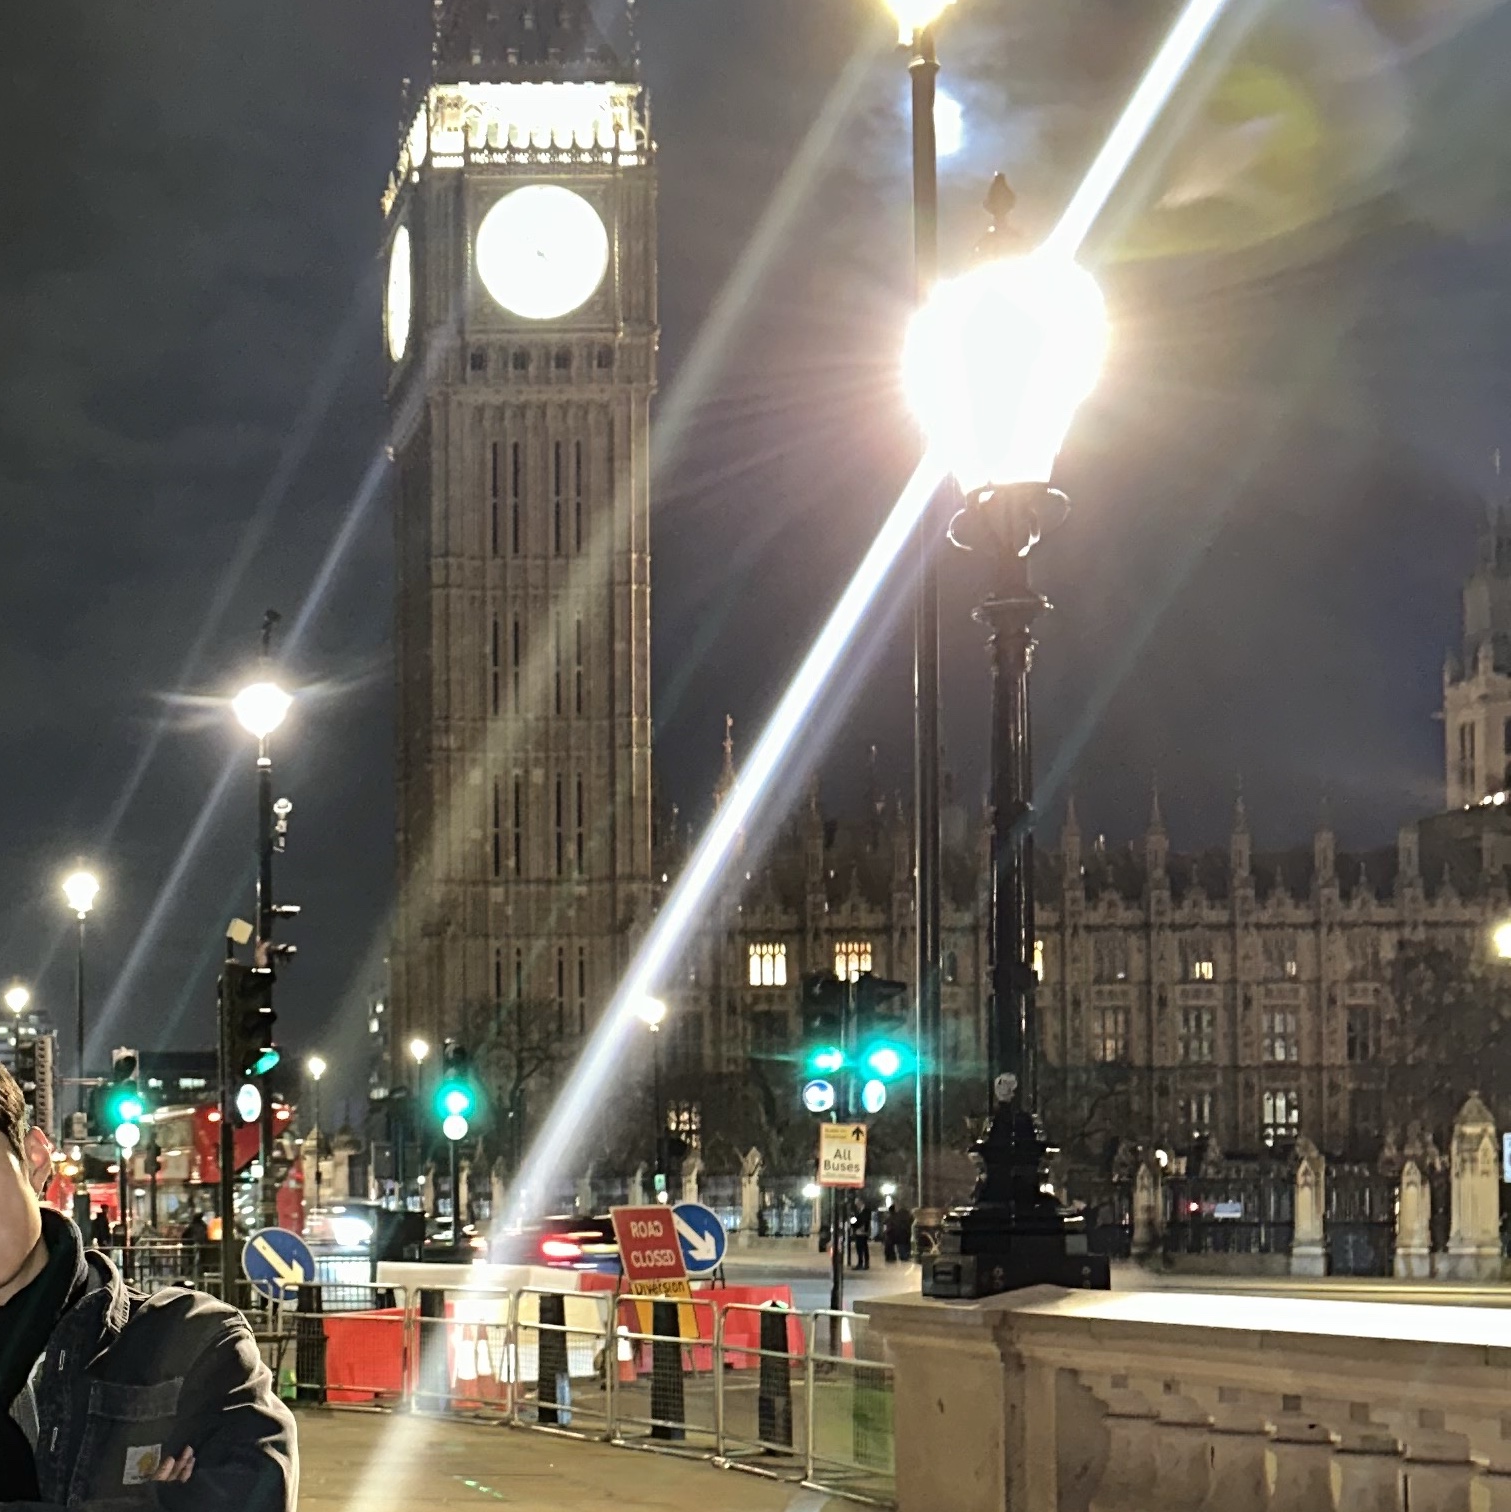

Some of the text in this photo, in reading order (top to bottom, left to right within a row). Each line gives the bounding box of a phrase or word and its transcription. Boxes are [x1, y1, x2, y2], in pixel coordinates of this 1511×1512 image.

[834, 1149, 851, 1160] All
[824, 1160, 860, 1172] Buses
[630, 1220, 664, 1238] ROAD
[631, 1249, 676, 1268] CLOSED
